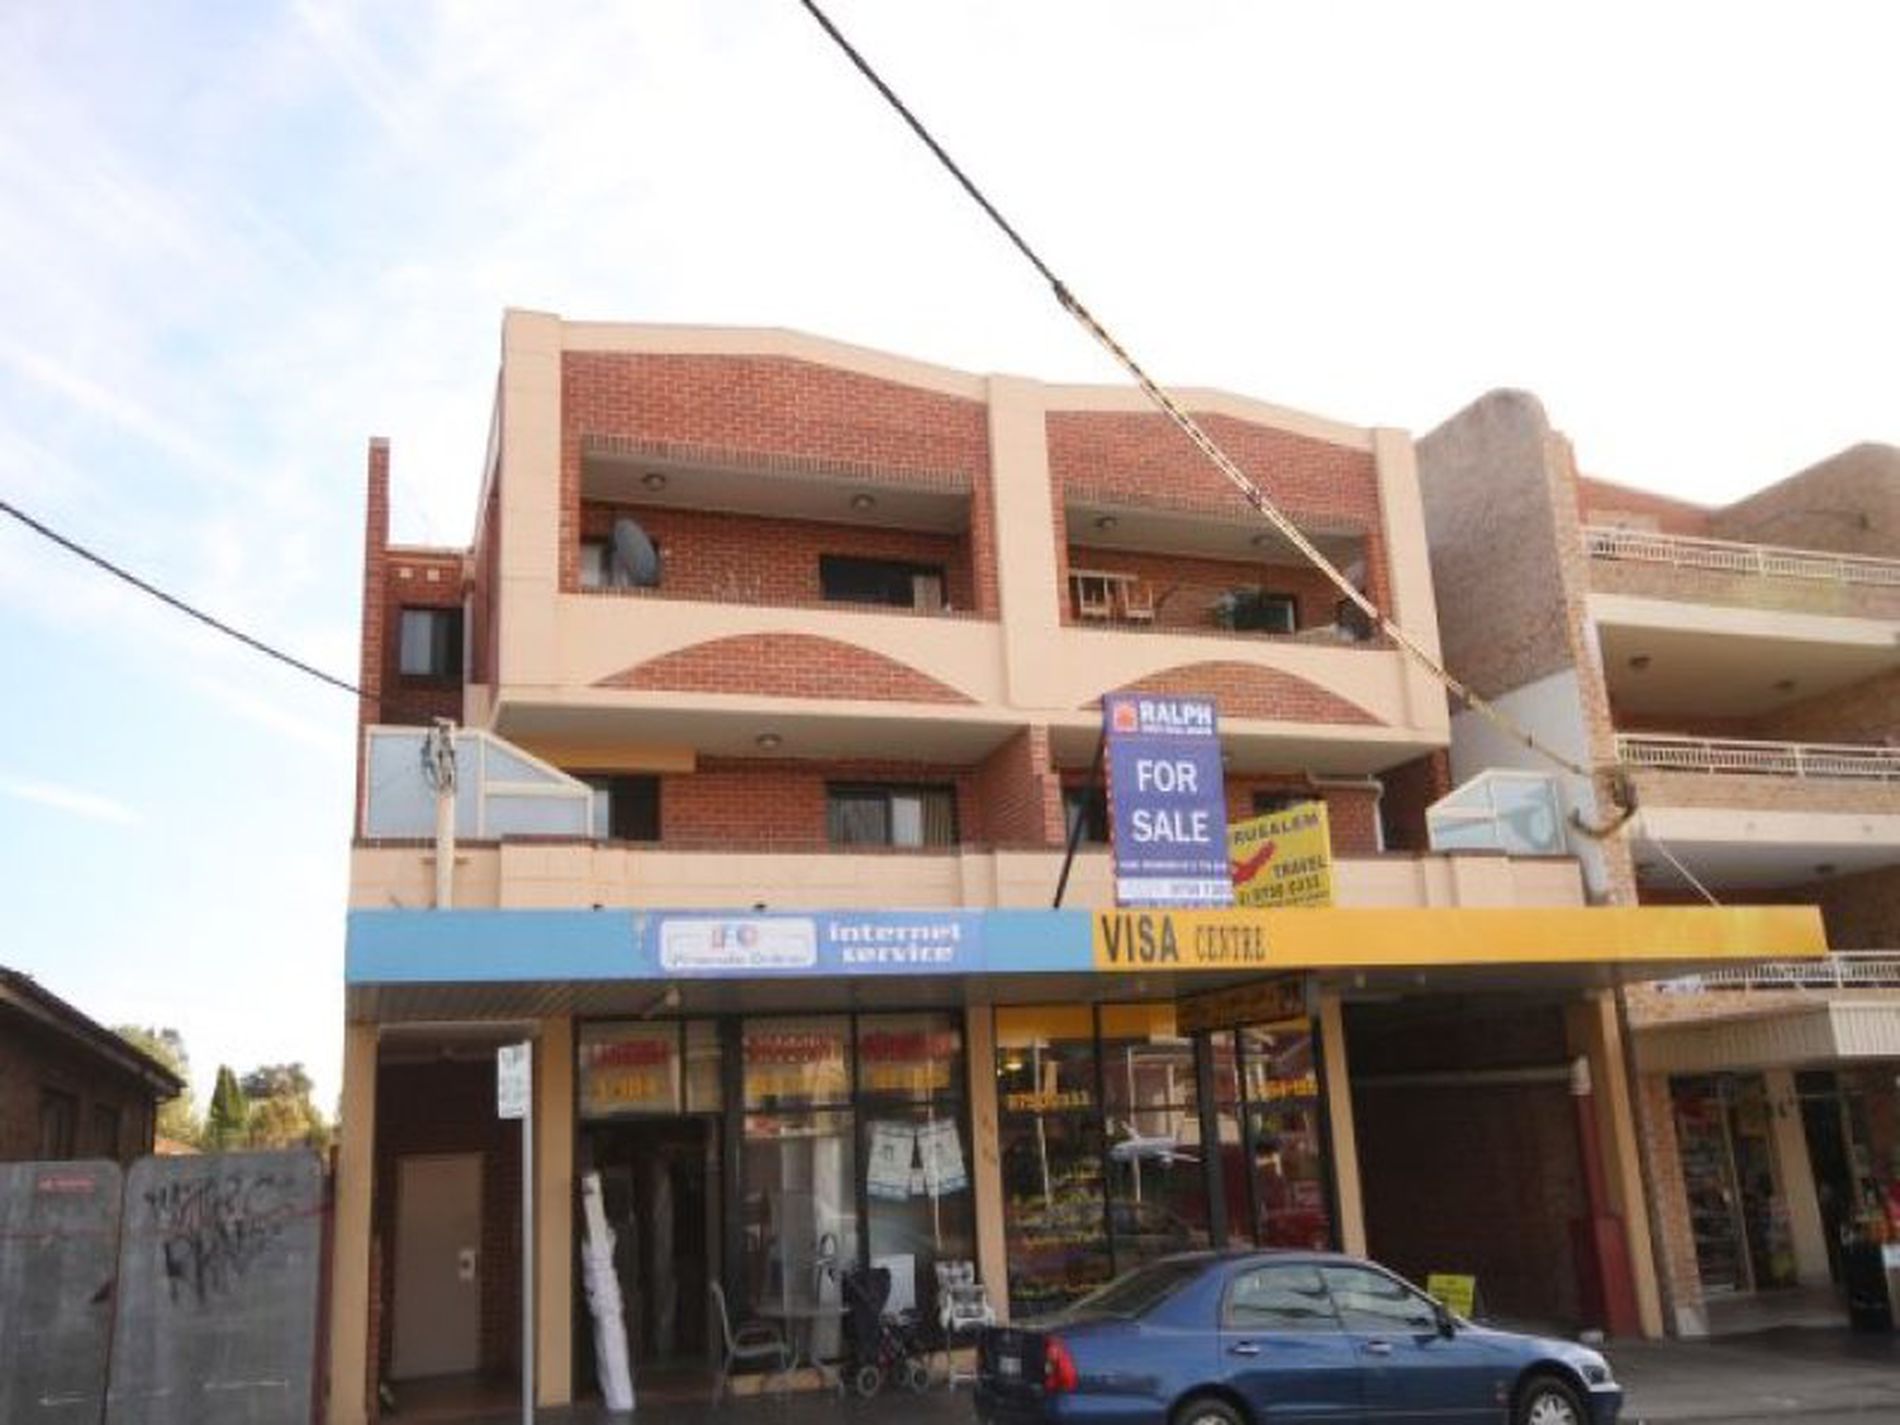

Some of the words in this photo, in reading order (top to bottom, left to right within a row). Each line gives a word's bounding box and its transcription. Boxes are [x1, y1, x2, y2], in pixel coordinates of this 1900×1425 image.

[1140, 701, 1212, 726] RALPH
[1137, 759, 1198, 792] FOR
[1132, 808, 1211, 842] SALE
[1273, 853, 1328, 878] TRAVEL
[1102, 913, 1179, 963] VISA
[1196, 924, 1267, 961] CENTRE
[842, 943, 954, 963] service
